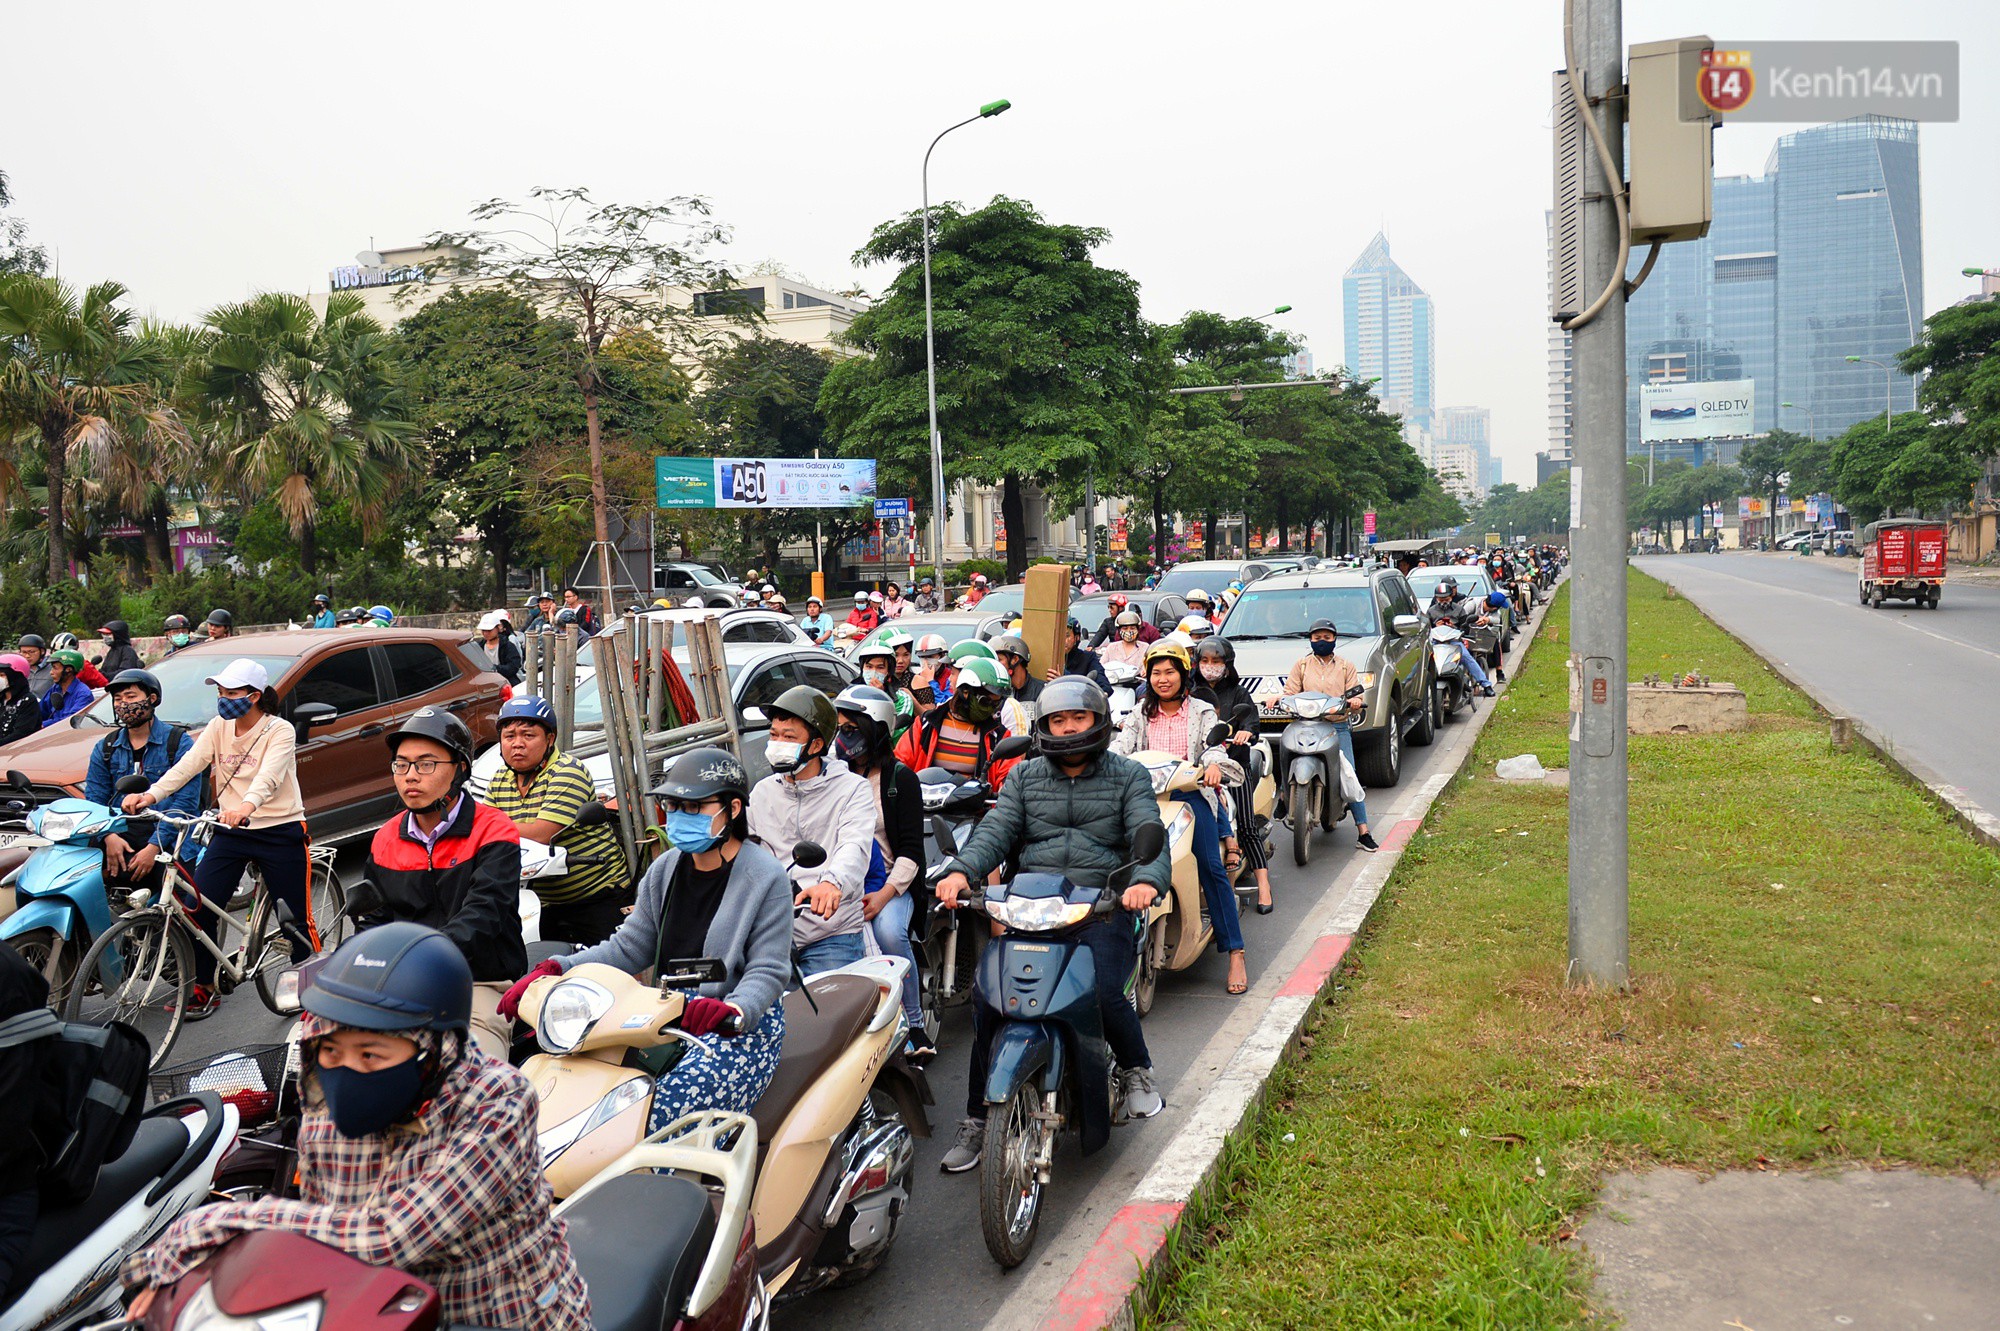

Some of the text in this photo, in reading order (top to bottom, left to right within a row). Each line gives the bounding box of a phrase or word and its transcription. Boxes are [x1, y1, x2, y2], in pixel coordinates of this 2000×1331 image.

[1701, 399, 1749, 412] QLED TV
[805, 462, 830, 471] Galaxy
[832, 462, 845, 470] A50
[732, 466, 767, 500] A50
[186, 531, 212, 544] Nail
